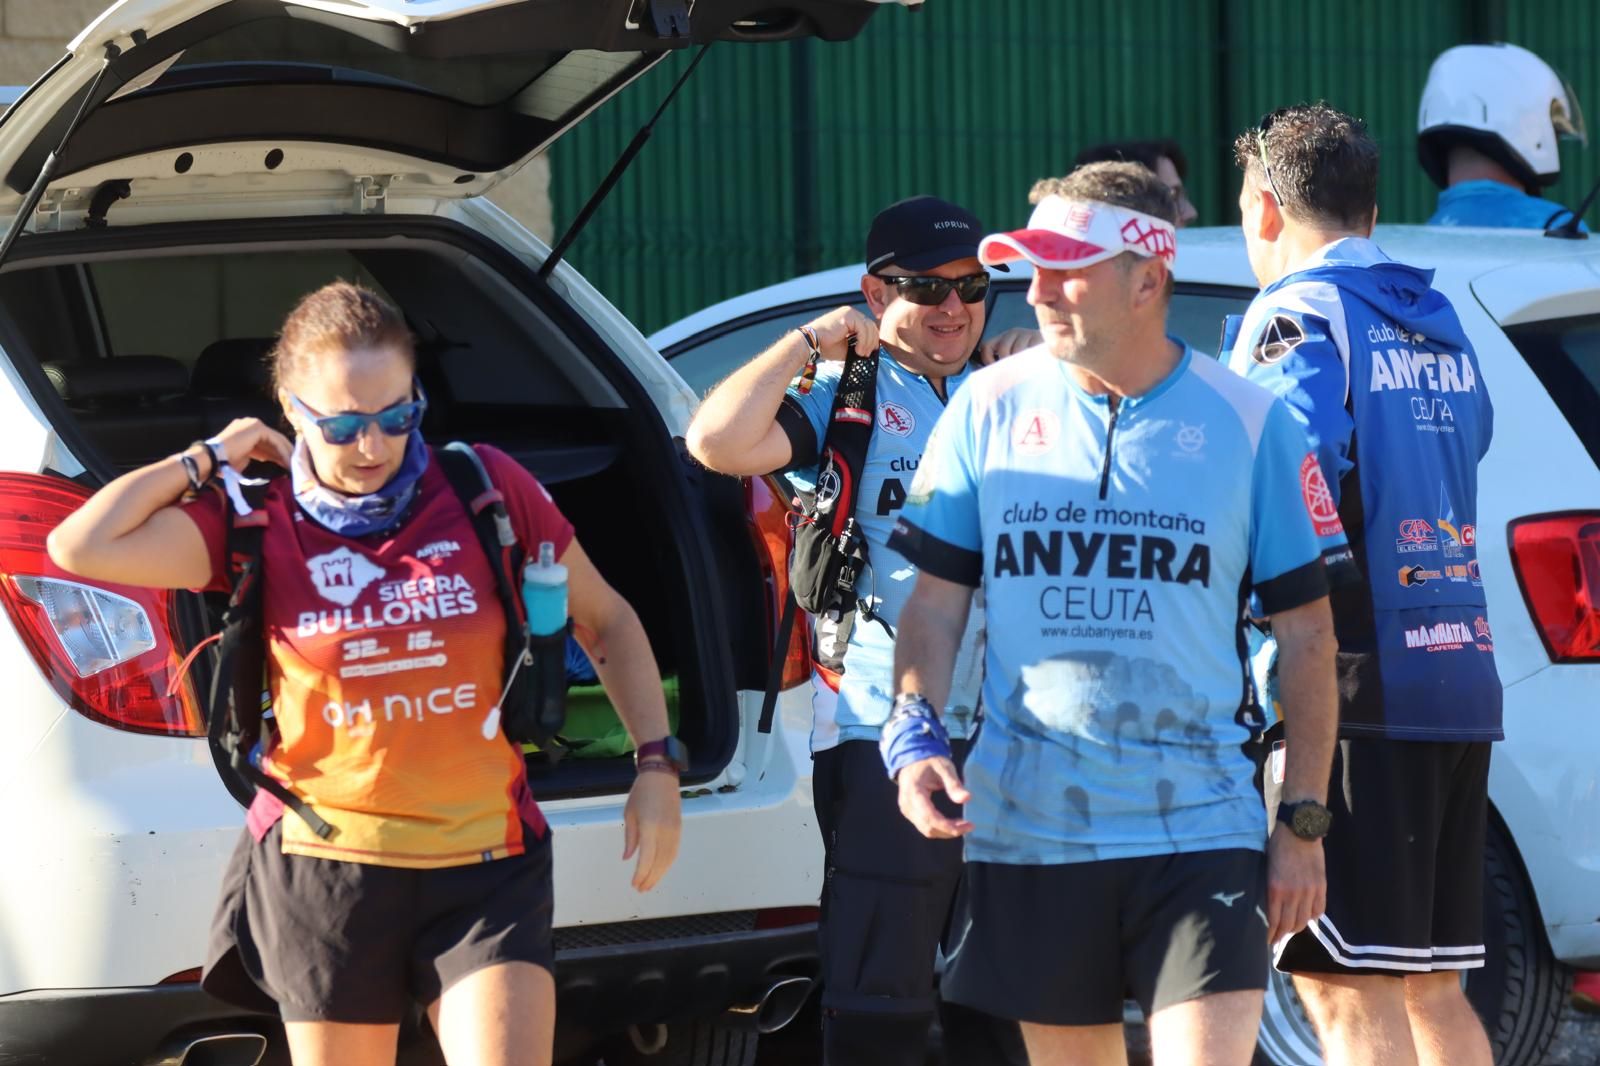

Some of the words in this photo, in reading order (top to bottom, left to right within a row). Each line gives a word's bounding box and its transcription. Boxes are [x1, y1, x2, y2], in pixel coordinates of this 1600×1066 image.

[934, 220, 970, 230] KIPRUN
[1368, 323, 1395, 343] club
[1370, 348, 1477, 393] ANYERA
[1003, 501, 1048, 525] club
[1056, 501, 1087, 524] de
[1095, 508, 1206, 535] montaña
[994, 530, 1211, 588] ANYERA
[379, 573, 472, 602] SIERRA
[297, 591, 478, 638] BULLONES
[1040, 586, 1155, 622] CEUTA
[1040, 625, 1153, 641] www.clubanyera.es
[322, 698, 373, 728] OH
